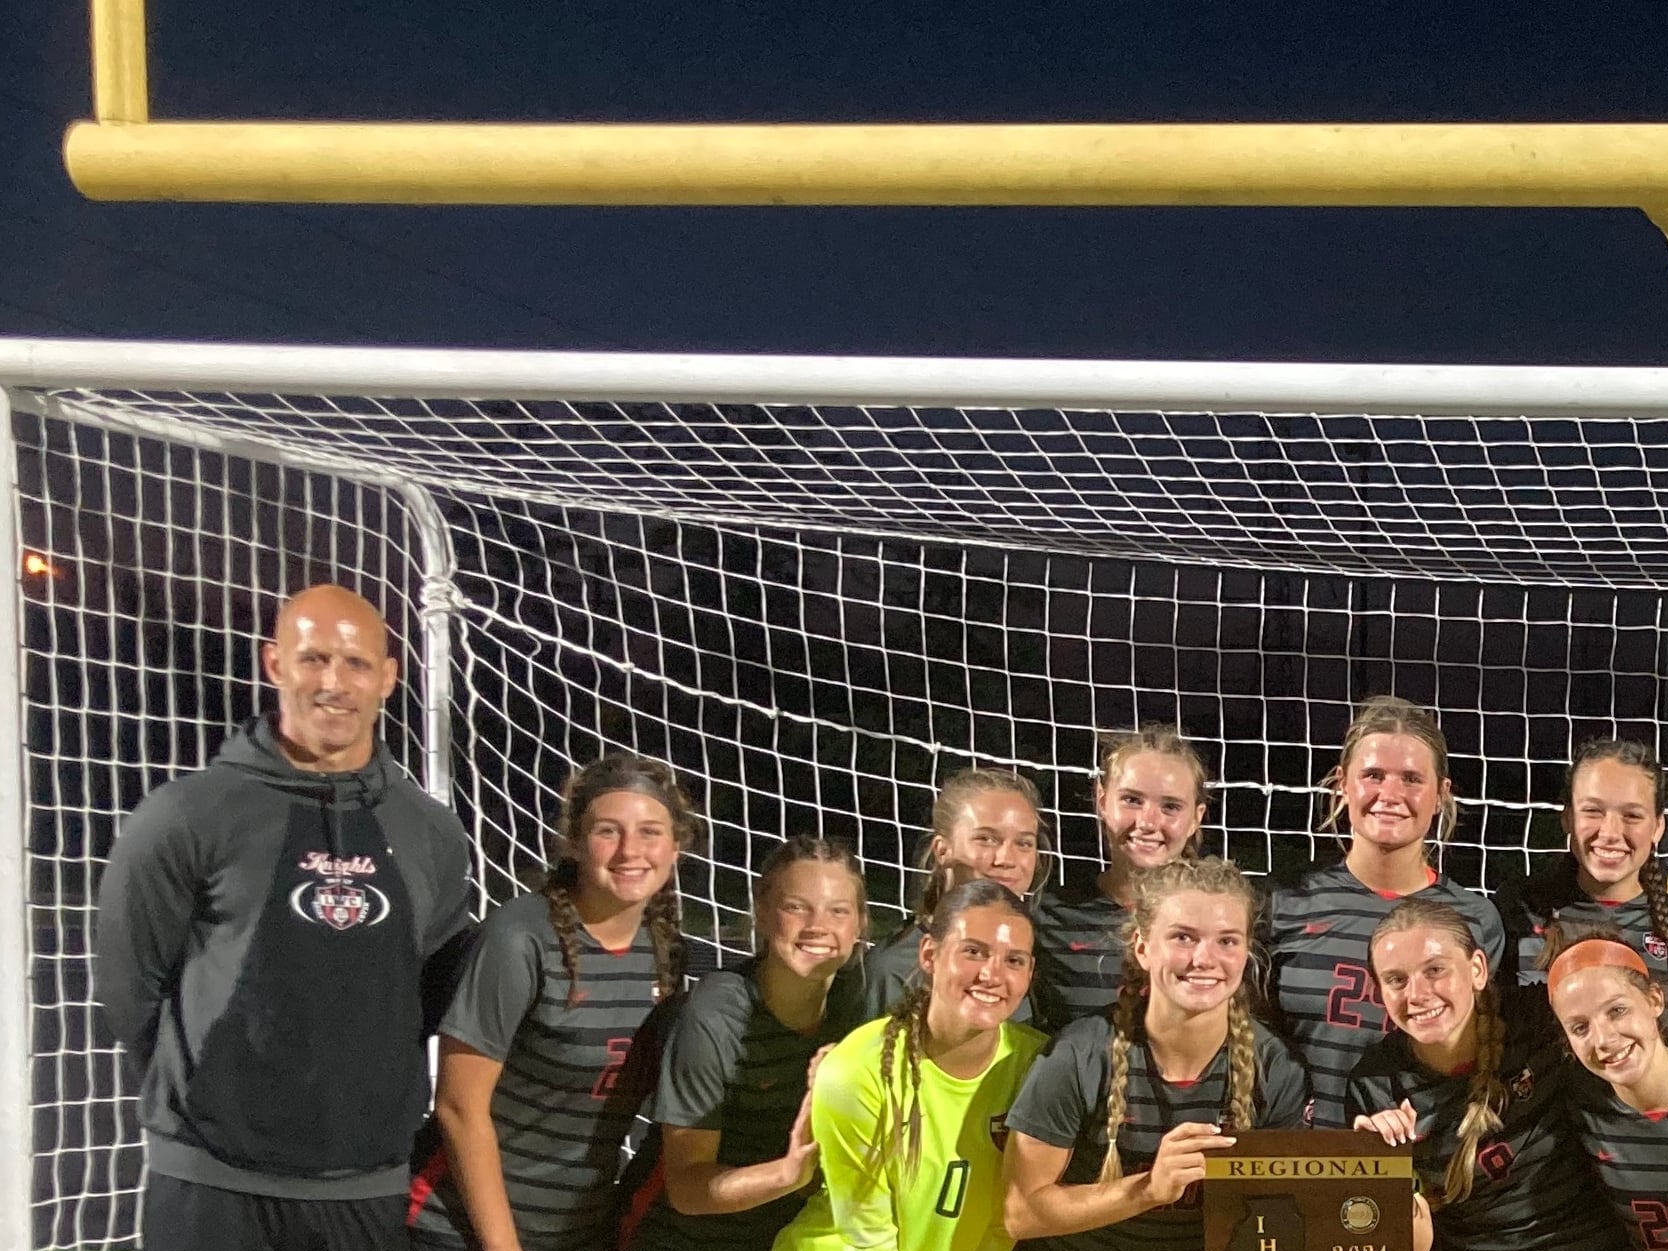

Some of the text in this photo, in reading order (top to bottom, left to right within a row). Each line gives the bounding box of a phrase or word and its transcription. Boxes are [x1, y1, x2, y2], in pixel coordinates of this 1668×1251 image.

[297, 851, 376, 876] Knights
[1229, 1160, 1389, 1176] REGIONAL
[935, 1159, 971, 1219] 0
